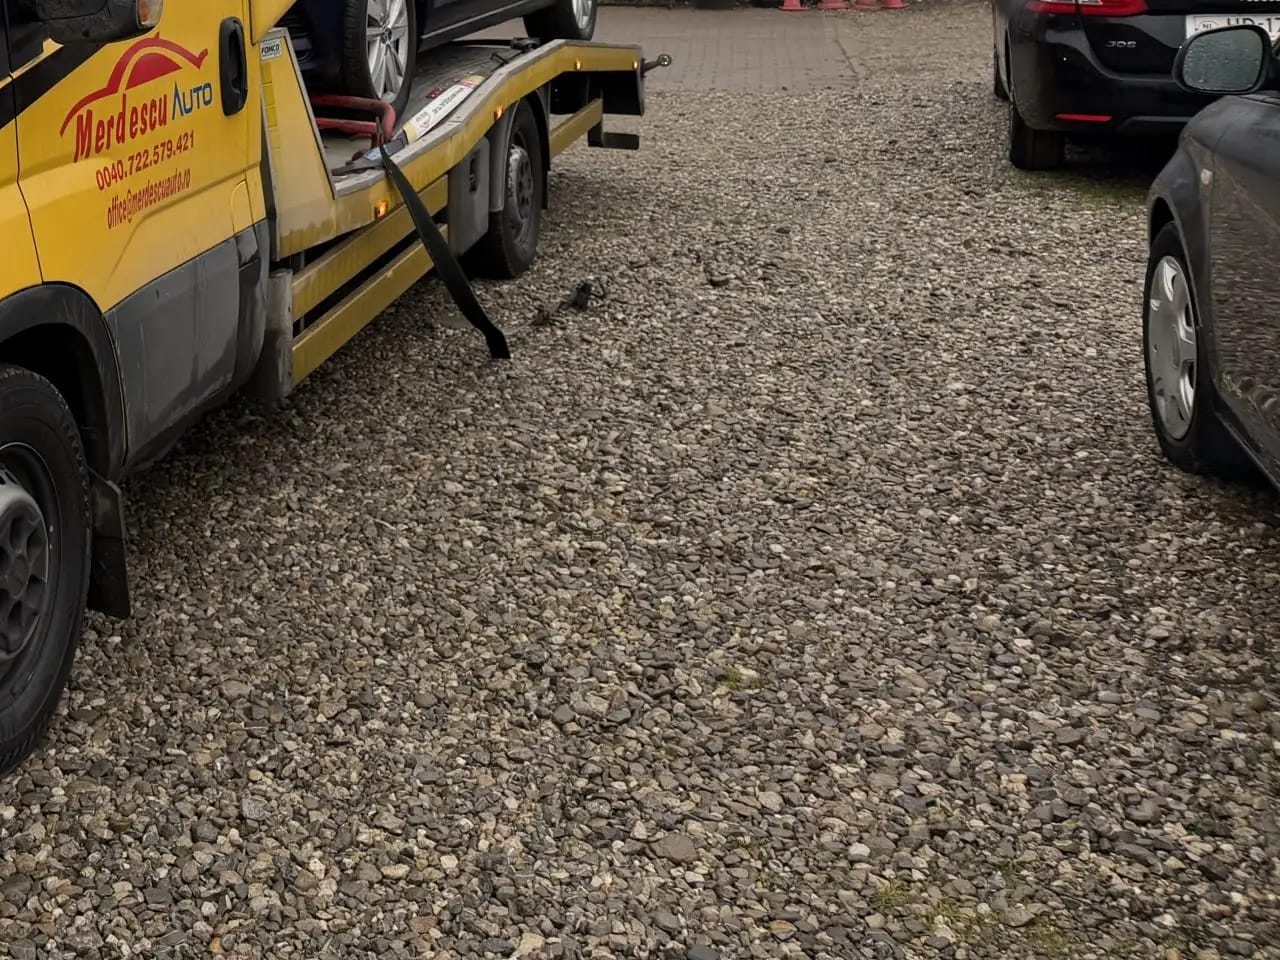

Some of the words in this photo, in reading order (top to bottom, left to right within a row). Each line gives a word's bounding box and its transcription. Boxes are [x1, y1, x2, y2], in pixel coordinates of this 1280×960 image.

[72, 93, 168, 163] Merdescu
[95, 129, 194, 191] 0040.722.579.421
[107, 167, 191, 230] office@merdescuauto.ro
